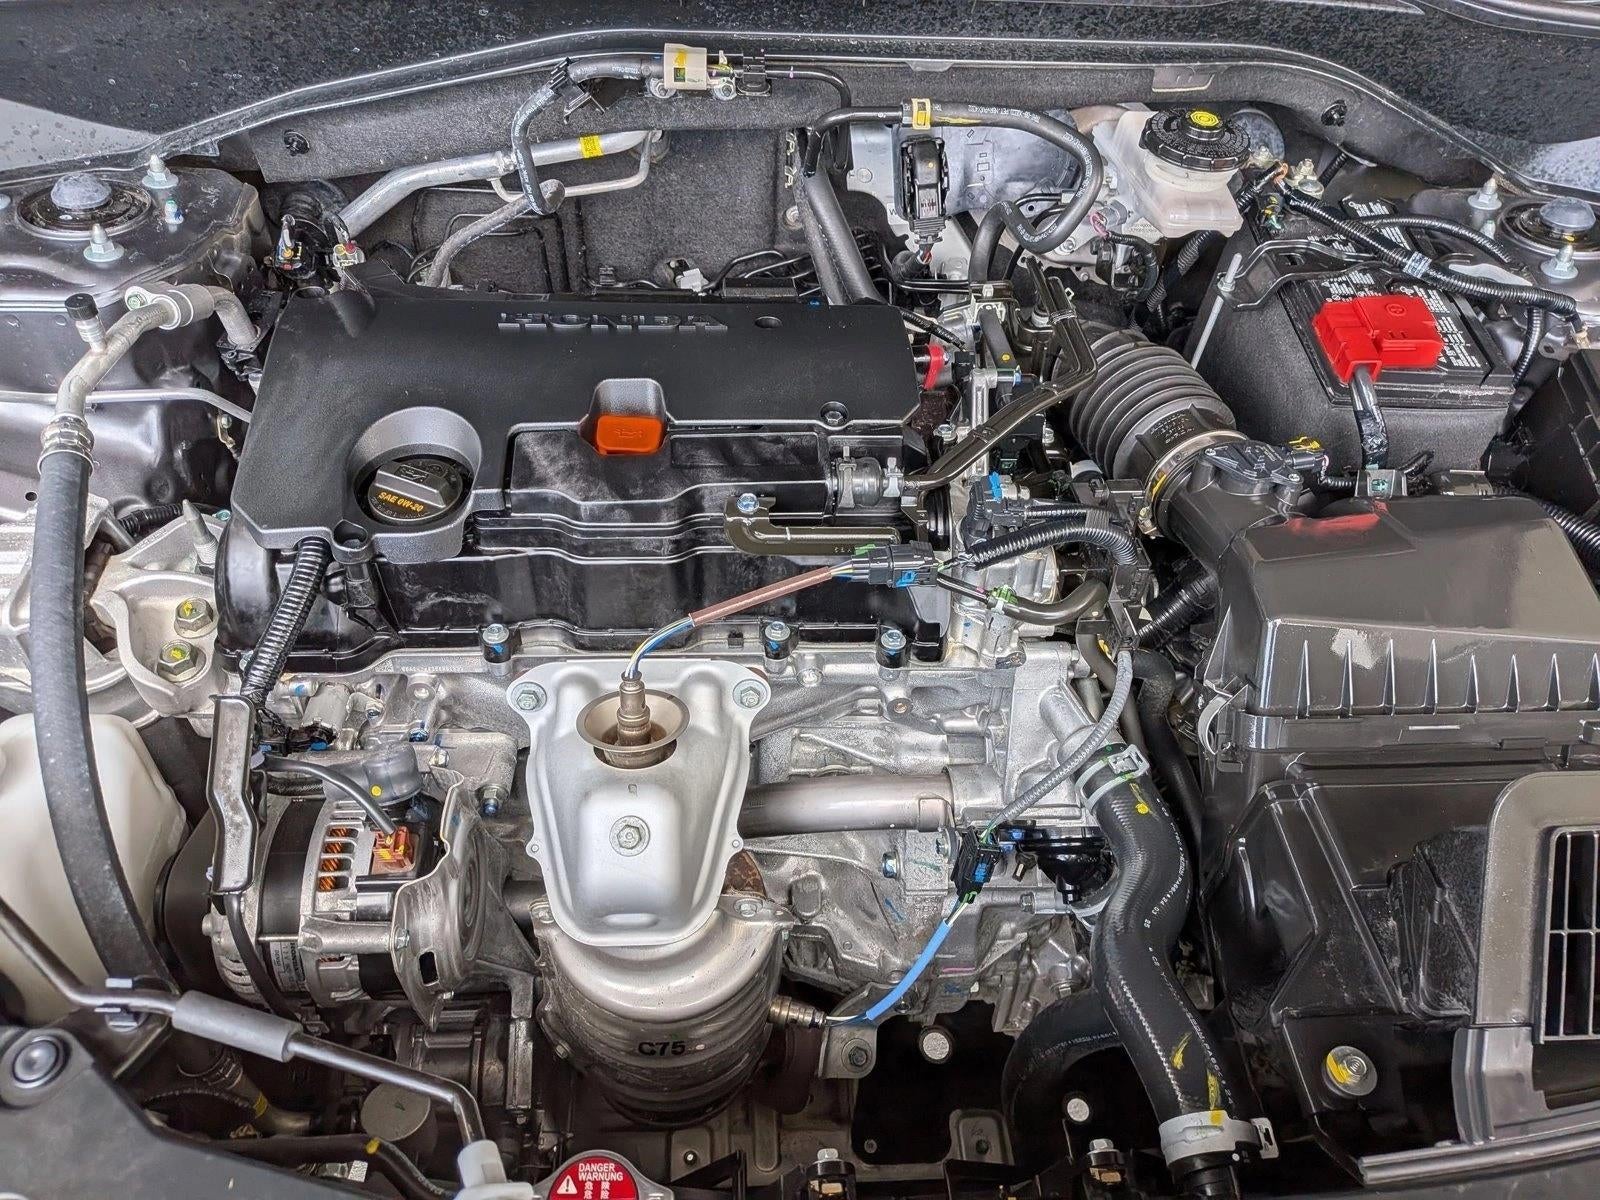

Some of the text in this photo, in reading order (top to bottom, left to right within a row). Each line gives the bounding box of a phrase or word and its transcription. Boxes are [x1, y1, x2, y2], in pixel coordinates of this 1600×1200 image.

[498, 313, 728, 330] HONDA
[378, 491, 424, 512] SAE 0W-20
[638, 1040, 686, 1057] C75
[578, 1163, 615, 1172] DANGER
[578, 1172, 623, 1181] WARNUNG
